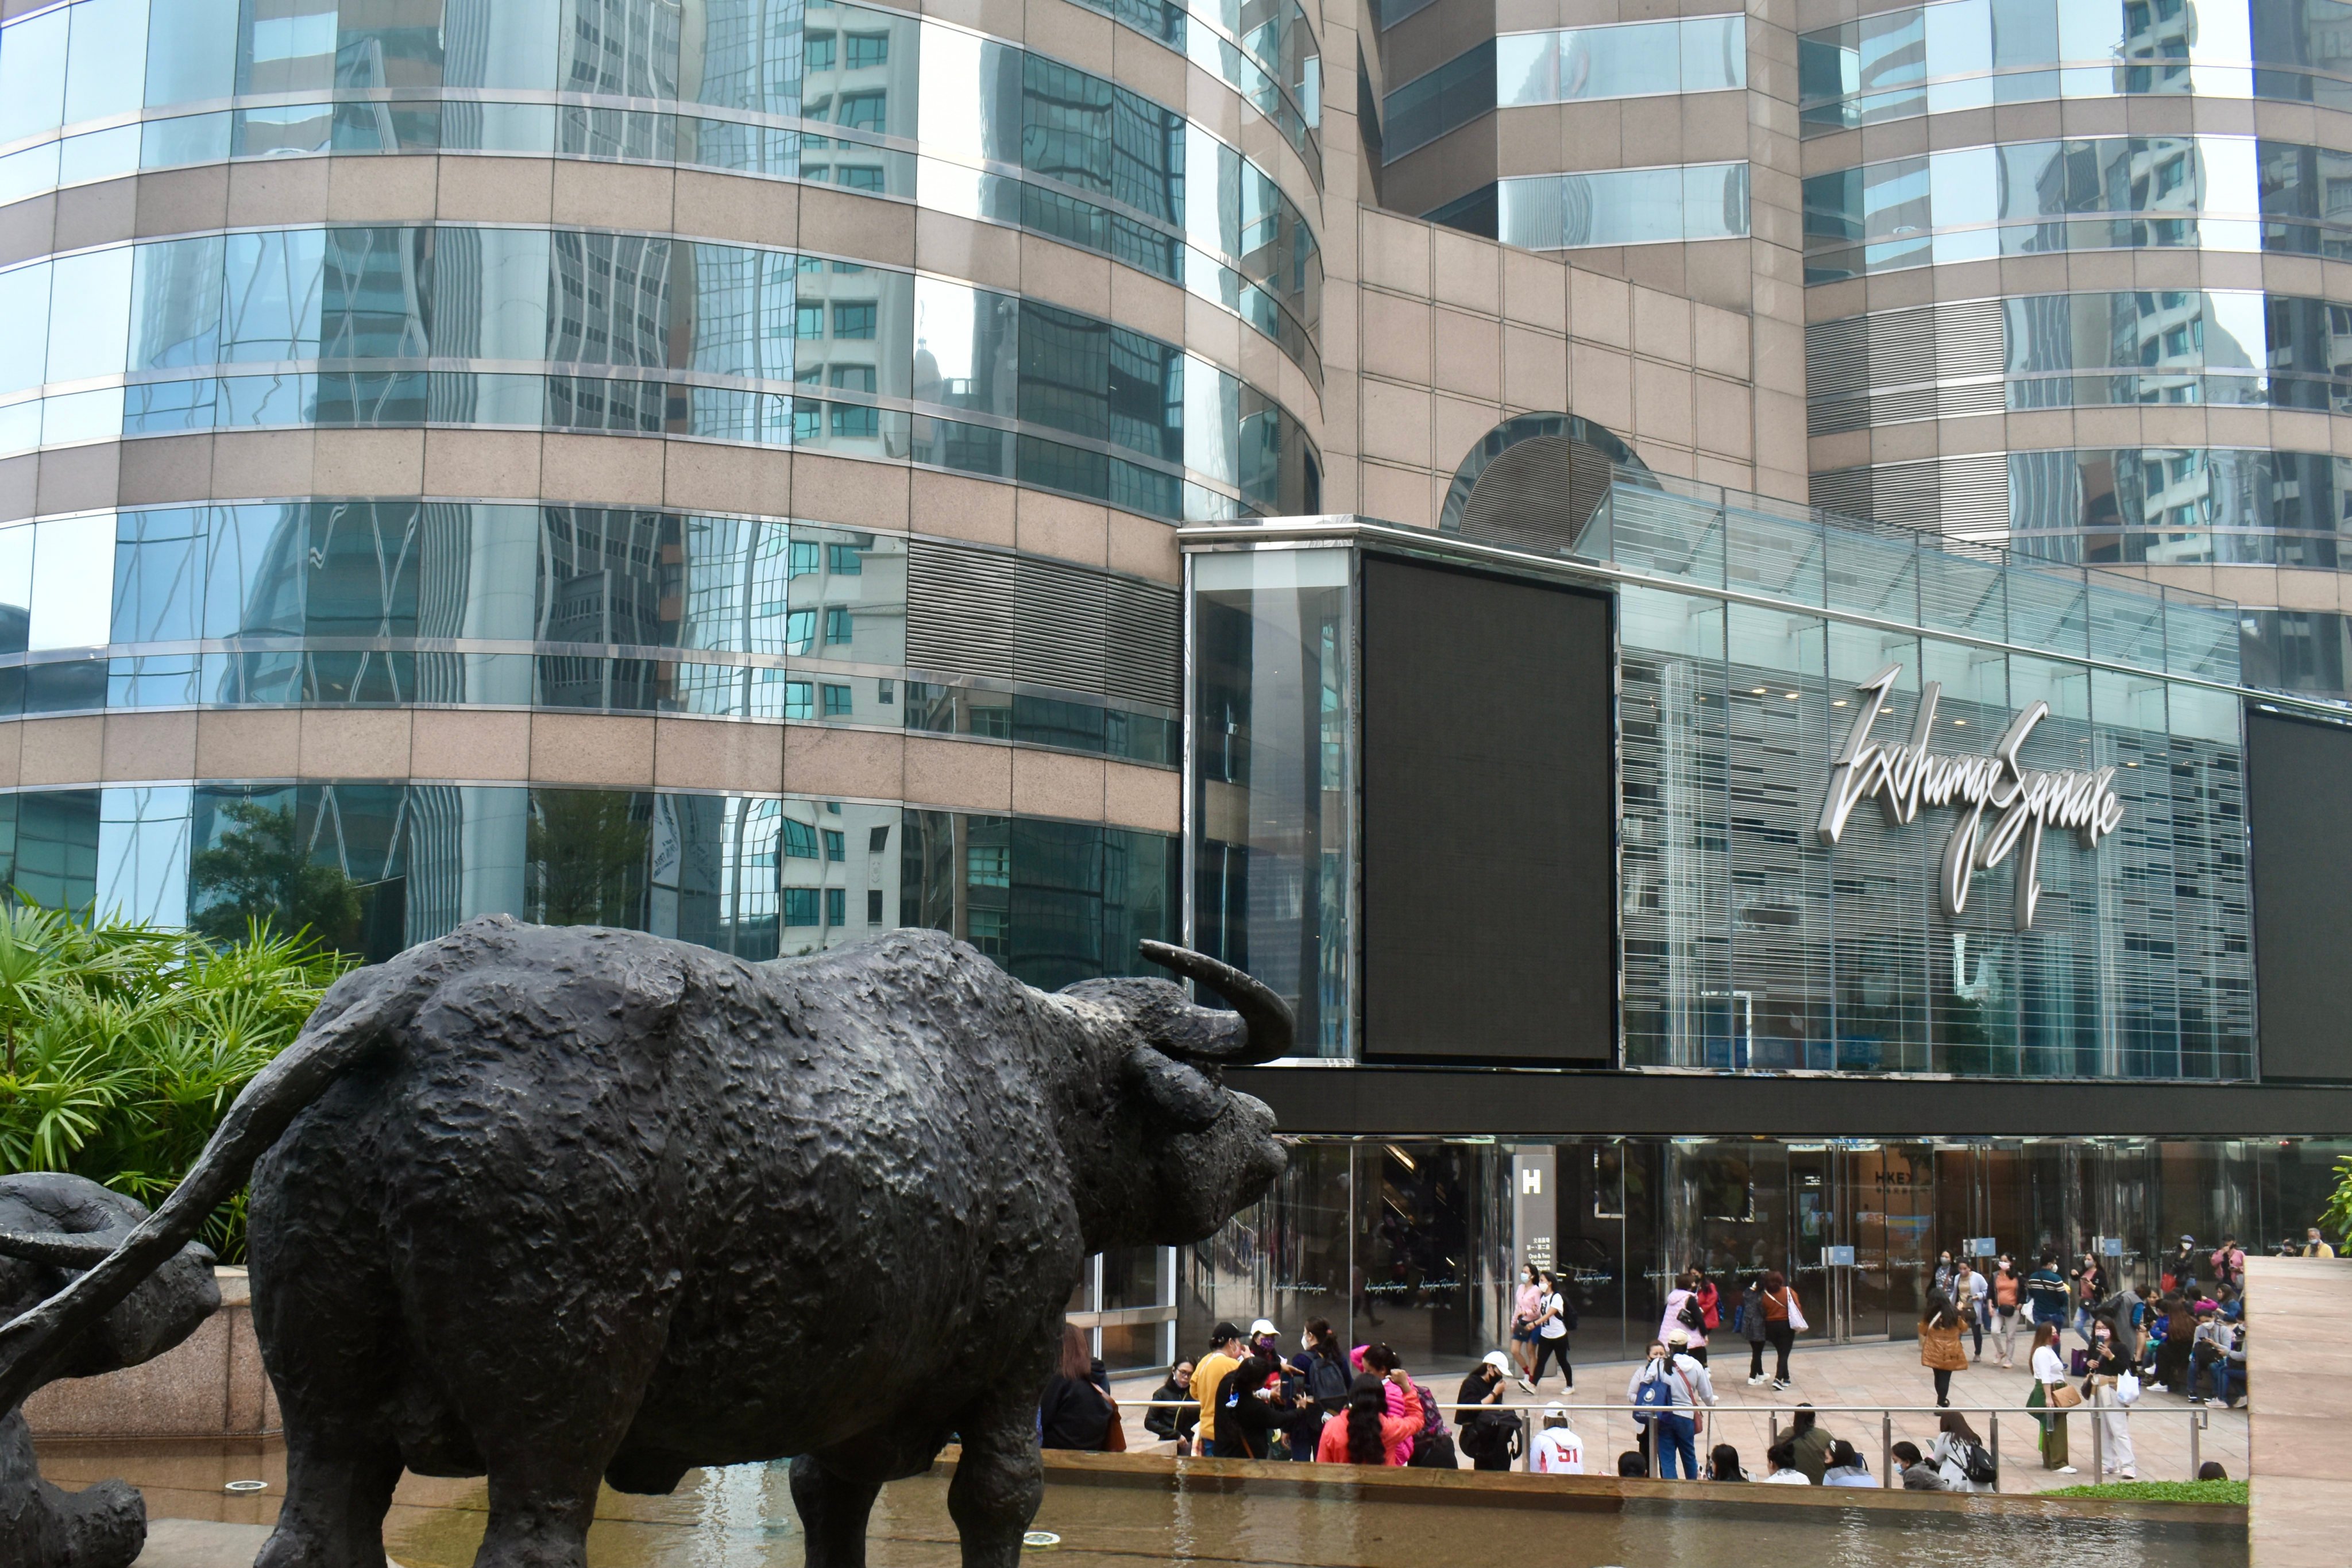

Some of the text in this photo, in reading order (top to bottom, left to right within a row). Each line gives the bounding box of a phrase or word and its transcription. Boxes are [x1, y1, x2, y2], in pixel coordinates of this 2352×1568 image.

[1817, 662, 2125, 930] Exchange Square
[1523, 1169, 1540, 1194] H
